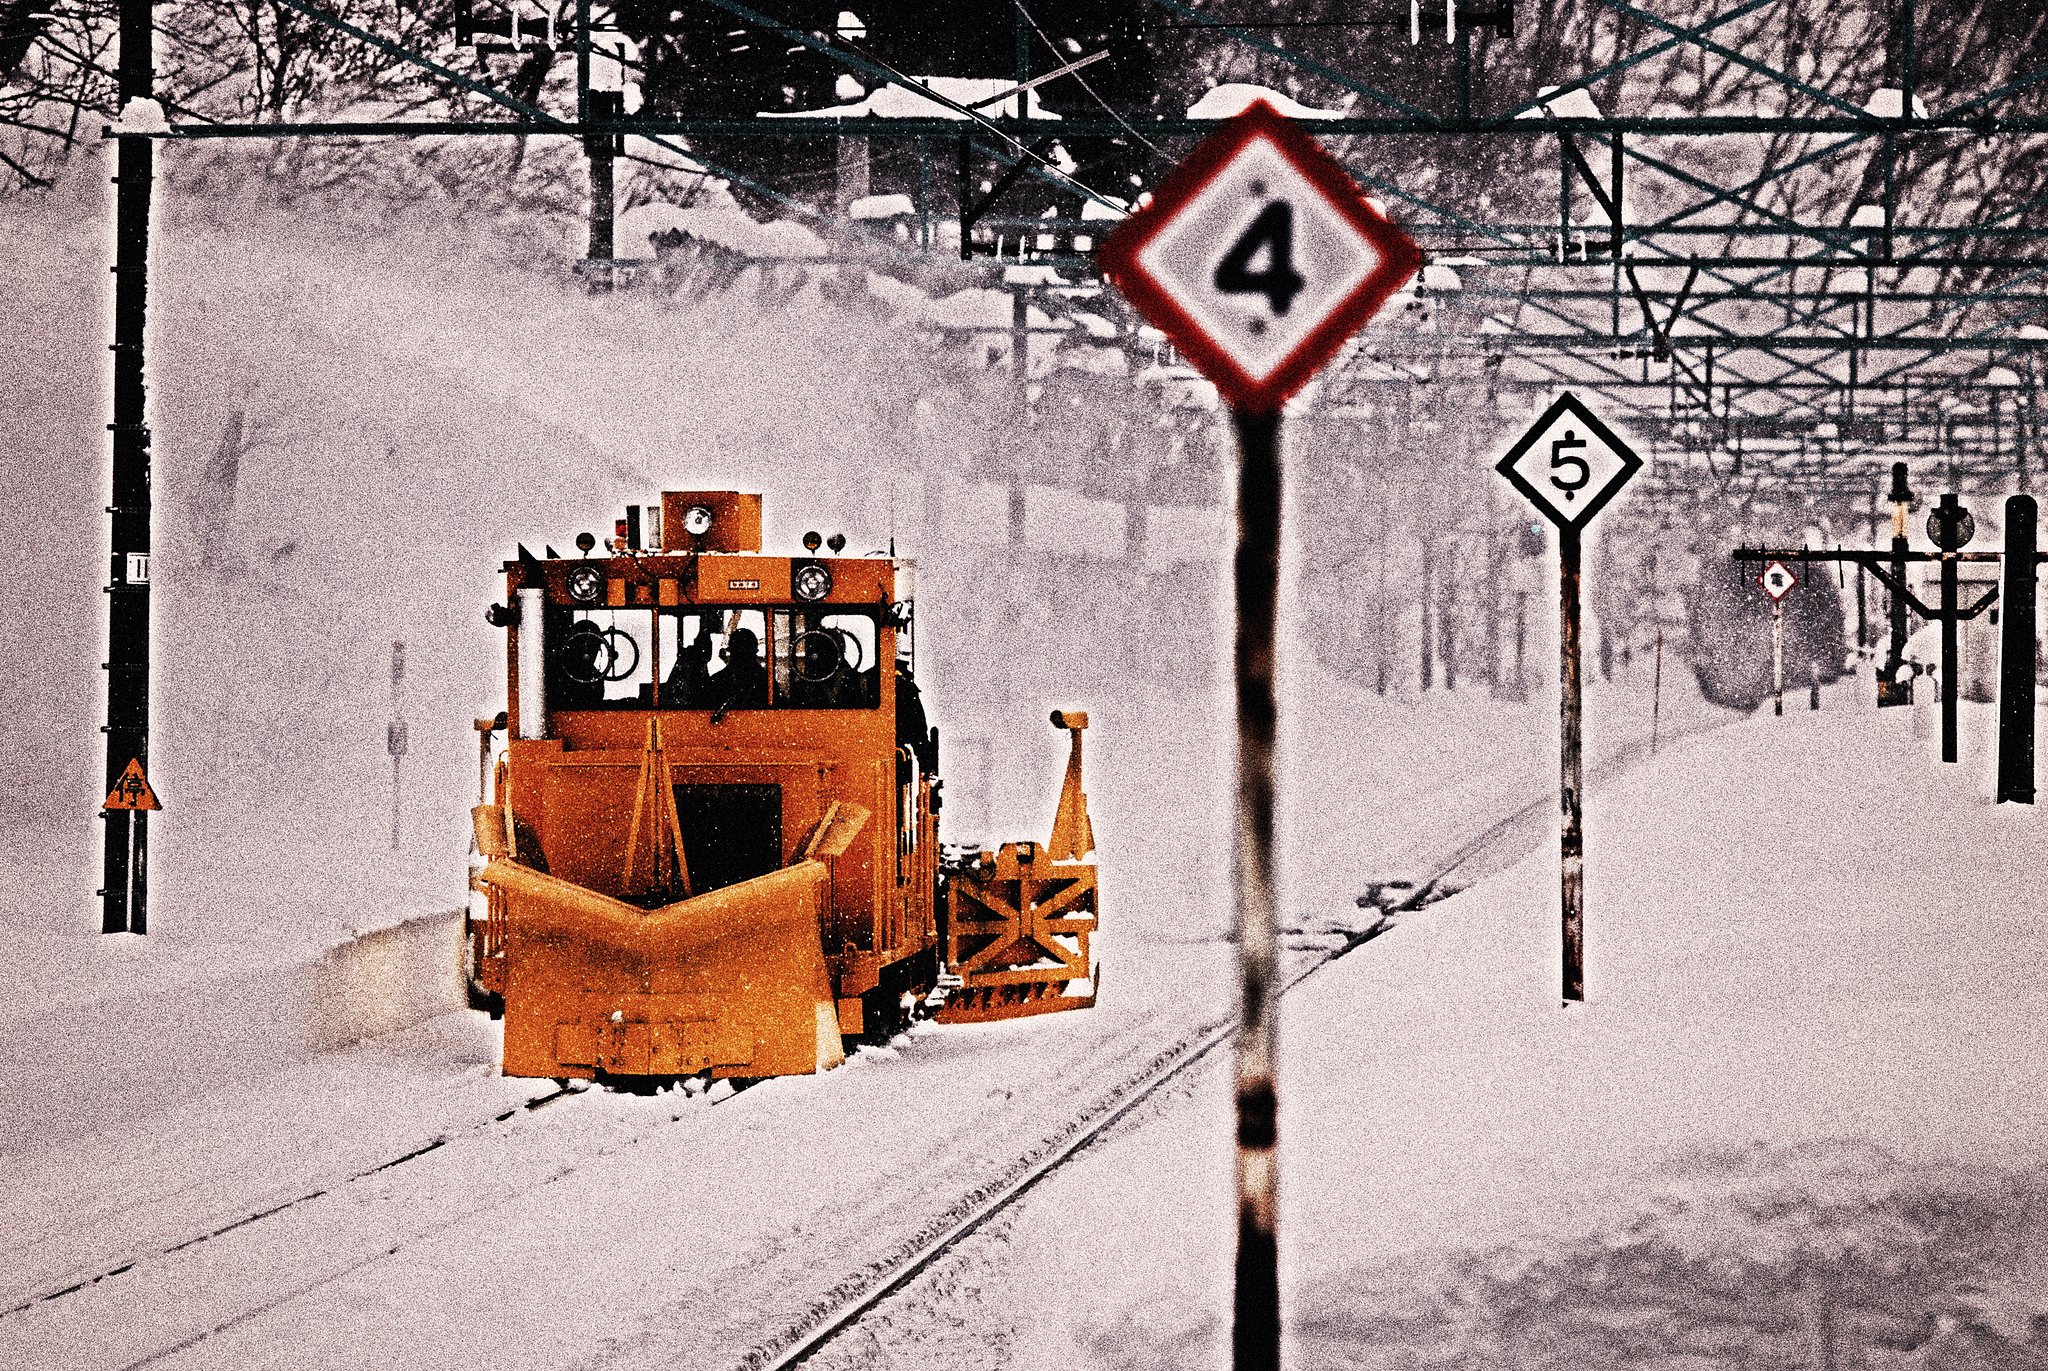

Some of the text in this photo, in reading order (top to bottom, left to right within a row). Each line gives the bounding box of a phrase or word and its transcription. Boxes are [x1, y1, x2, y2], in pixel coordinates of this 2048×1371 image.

[1214, 197, 1305, 316] 4
[1550, 440, 1590, 491] 5
[114, 773, 146, 806] 停
